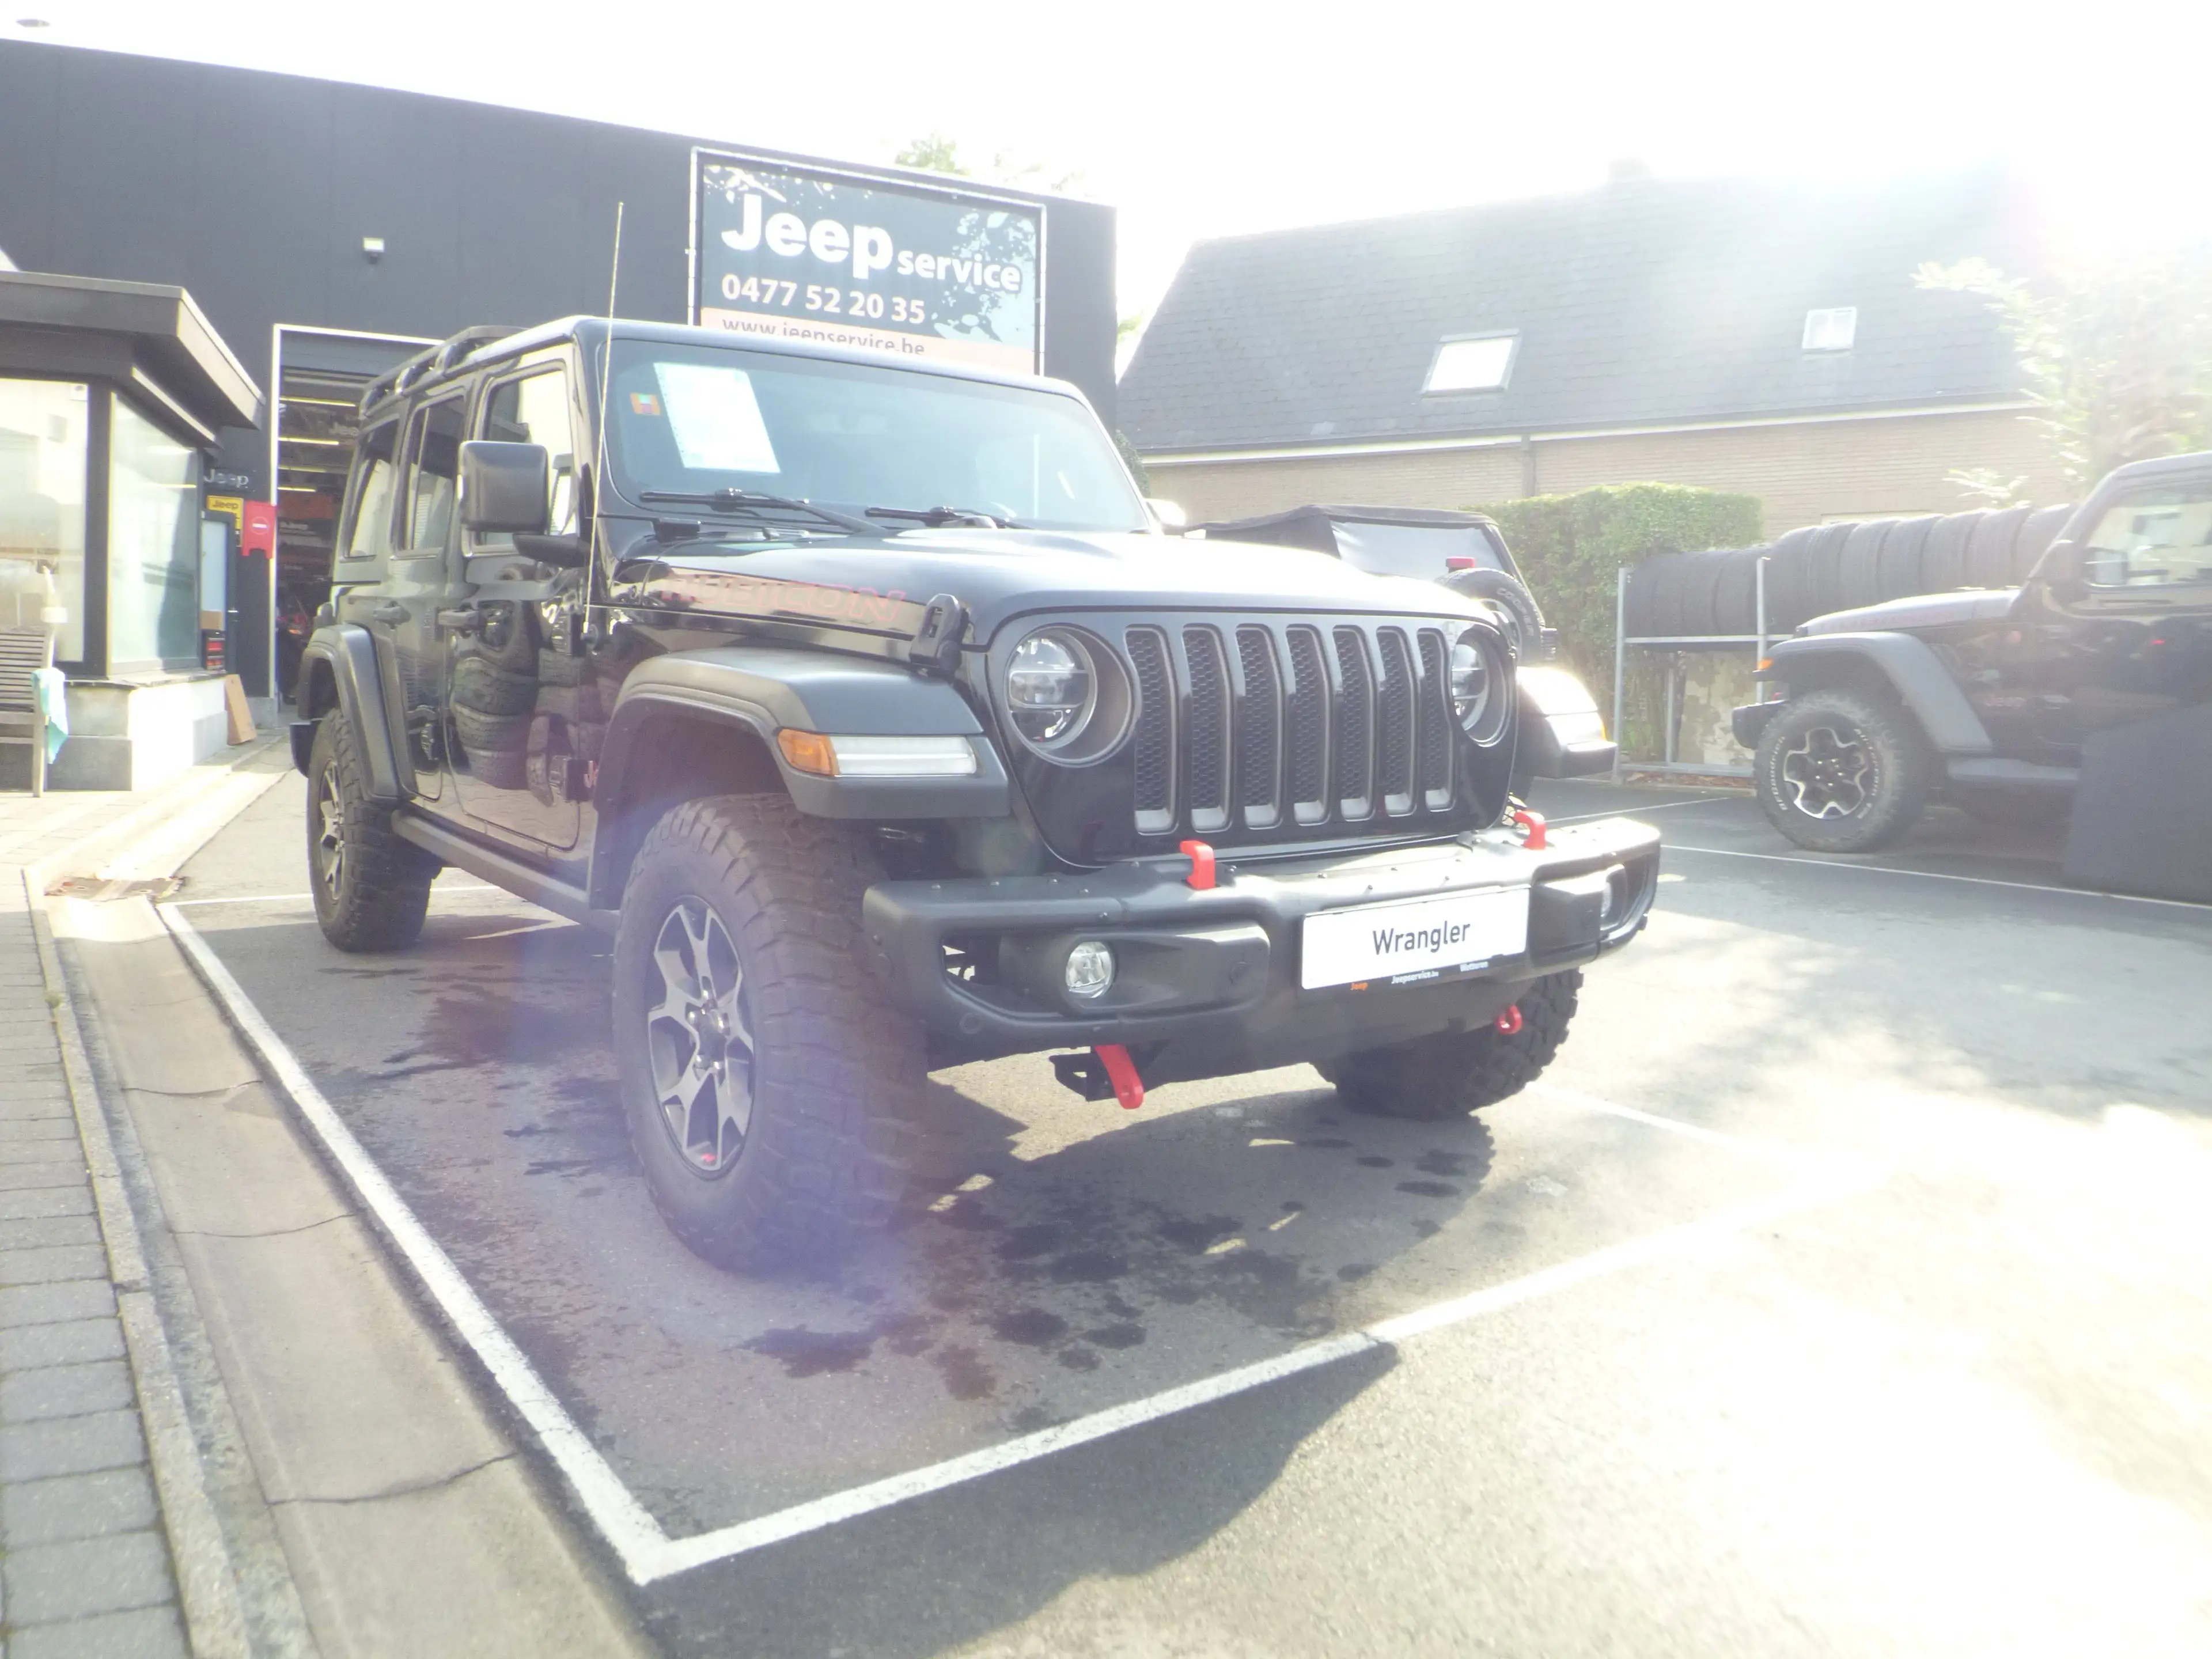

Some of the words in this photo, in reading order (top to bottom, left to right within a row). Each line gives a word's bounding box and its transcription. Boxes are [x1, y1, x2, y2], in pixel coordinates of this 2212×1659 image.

[721, 194, 894, 280] Jeep
[897, 249, 1022, 291] service
[721, 274, 798, 307] 0477
[805, 285, 842, 314] 52
[849, 292, 884, 319] 20
[891, 297, 926, 324] 35
[203, 468, 249, 488] Jeep
[212, 500, 238, 510] Jeep
[1372, 920, 1471, 956] Wrangler
